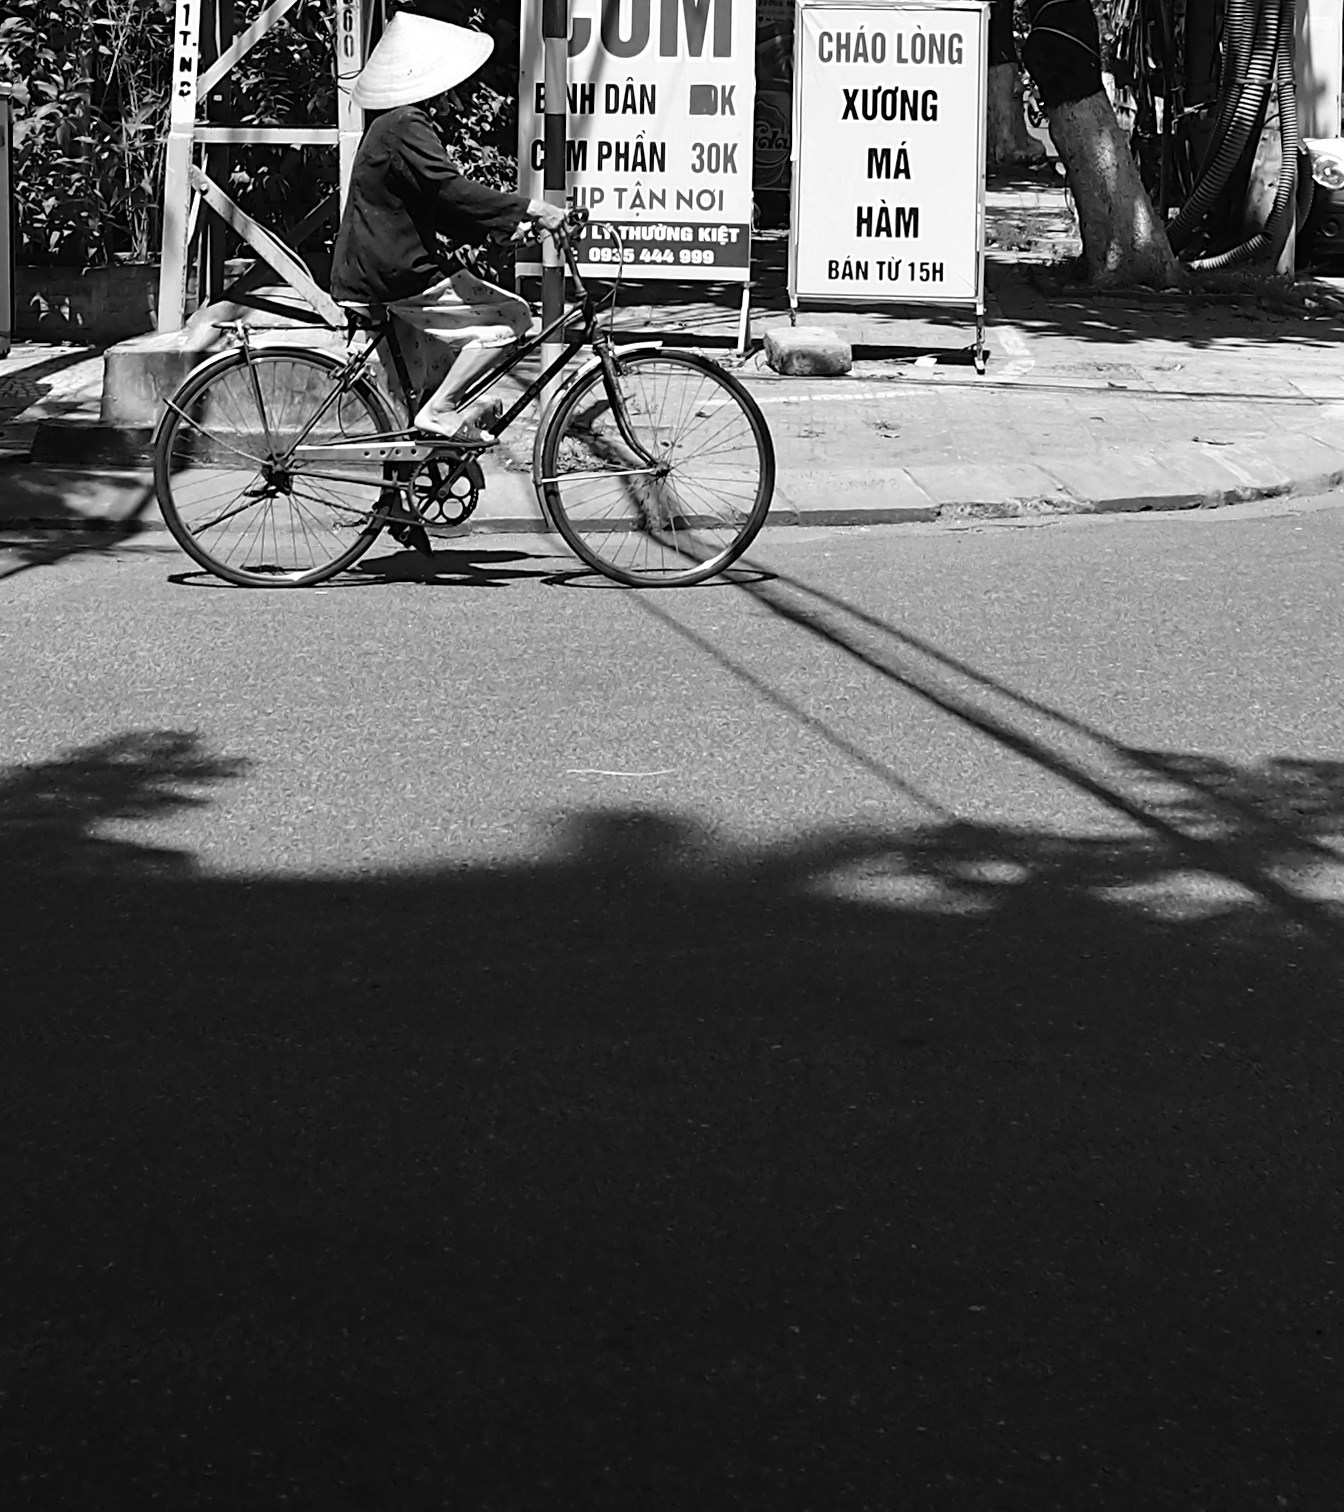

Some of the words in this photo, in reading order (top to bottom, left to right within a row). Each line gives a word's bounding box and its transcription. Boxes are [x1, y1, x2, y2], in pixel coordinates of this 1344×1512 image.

[818, 25, 887, 63] CHÁO
[896, 25, 963, 64] LÒNG
[535, 83, 595, 115] BNH
[605, 77, 656, 115] DÂN
[841, 86, 938, 121] XƯƠNG
[531, 139, 587, 172] CM
[597, 130, 666, 172] PHẦN
[691, 142, 738, 174] 30K
[867, 141, 911, 179] MÁ
[613, 180, 666, 217] TẬN
[676, 188, 724, 211] NƠI
[618, 224, 694, 242] THƯỜNG
[698, 225, 741, 246] KIỆT
[856, 199, 919, 238] HÀM
[588, 247, 635, 263] 0935
[639, 249, 675, 263] 444
[679, 249, 715, 264] 999
[828, 255, 869, 281] BÁN
[876, 256, 902, 281] TỪ
[907, 262, 944, 282] 15H
